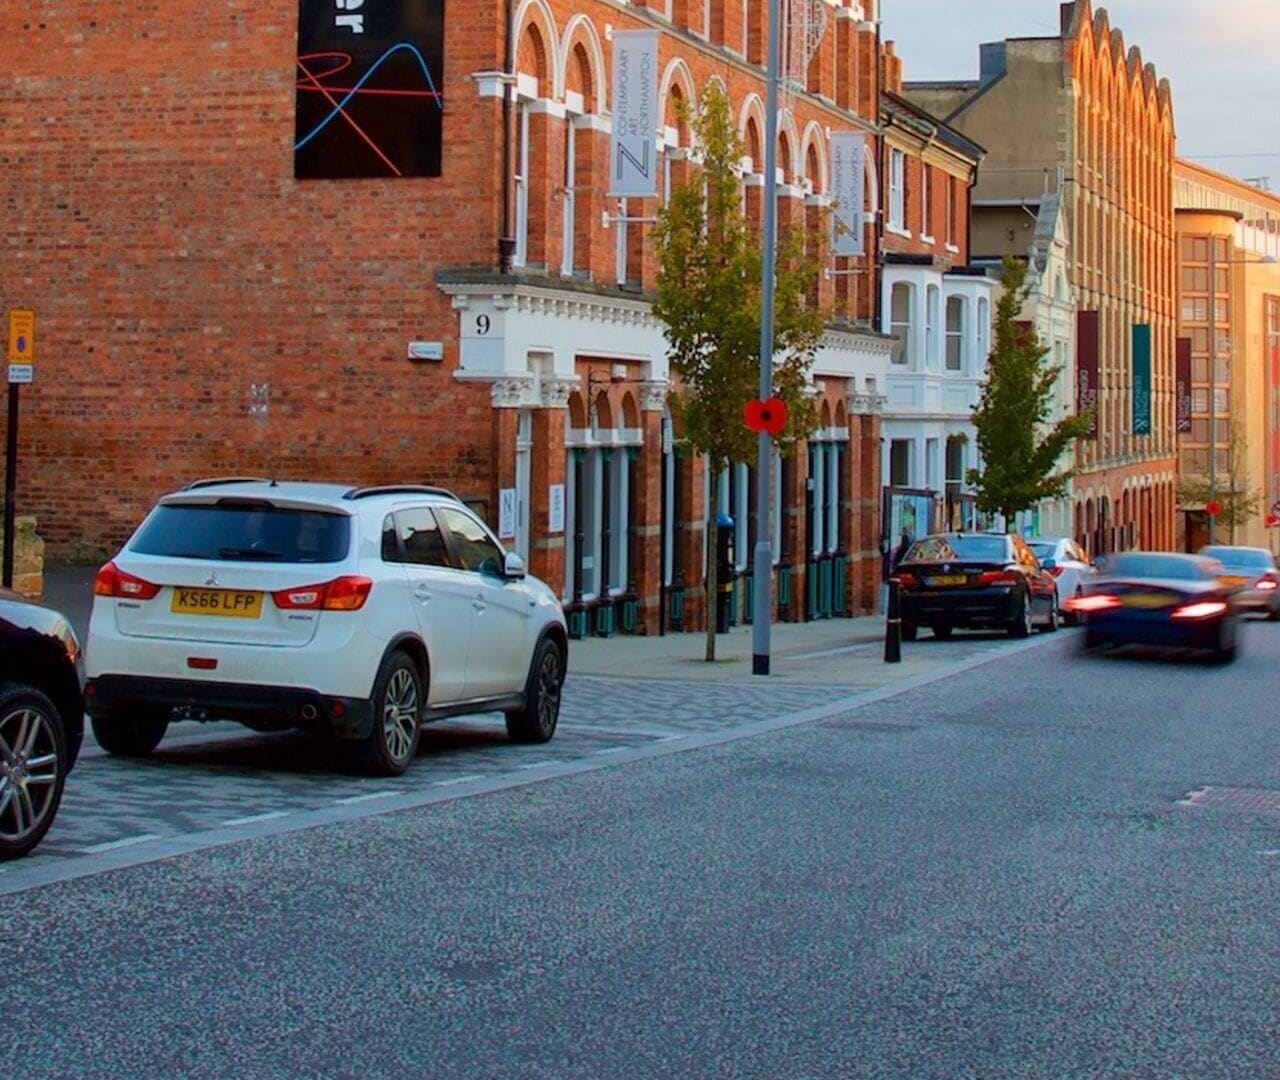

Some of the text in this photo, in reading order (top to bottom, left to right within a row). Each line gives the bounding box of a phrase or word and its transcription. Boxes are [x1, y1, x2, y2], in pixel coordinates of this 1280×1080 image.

[618, 49, 629, 137] CONTEMPORARY
[639, 51, 650, 137] NORTHAMPTON
[629, 117, 637, 136] ART
[476, 313, 491, 336] 9
[178, 591, 255, 610] KS66 LFP
